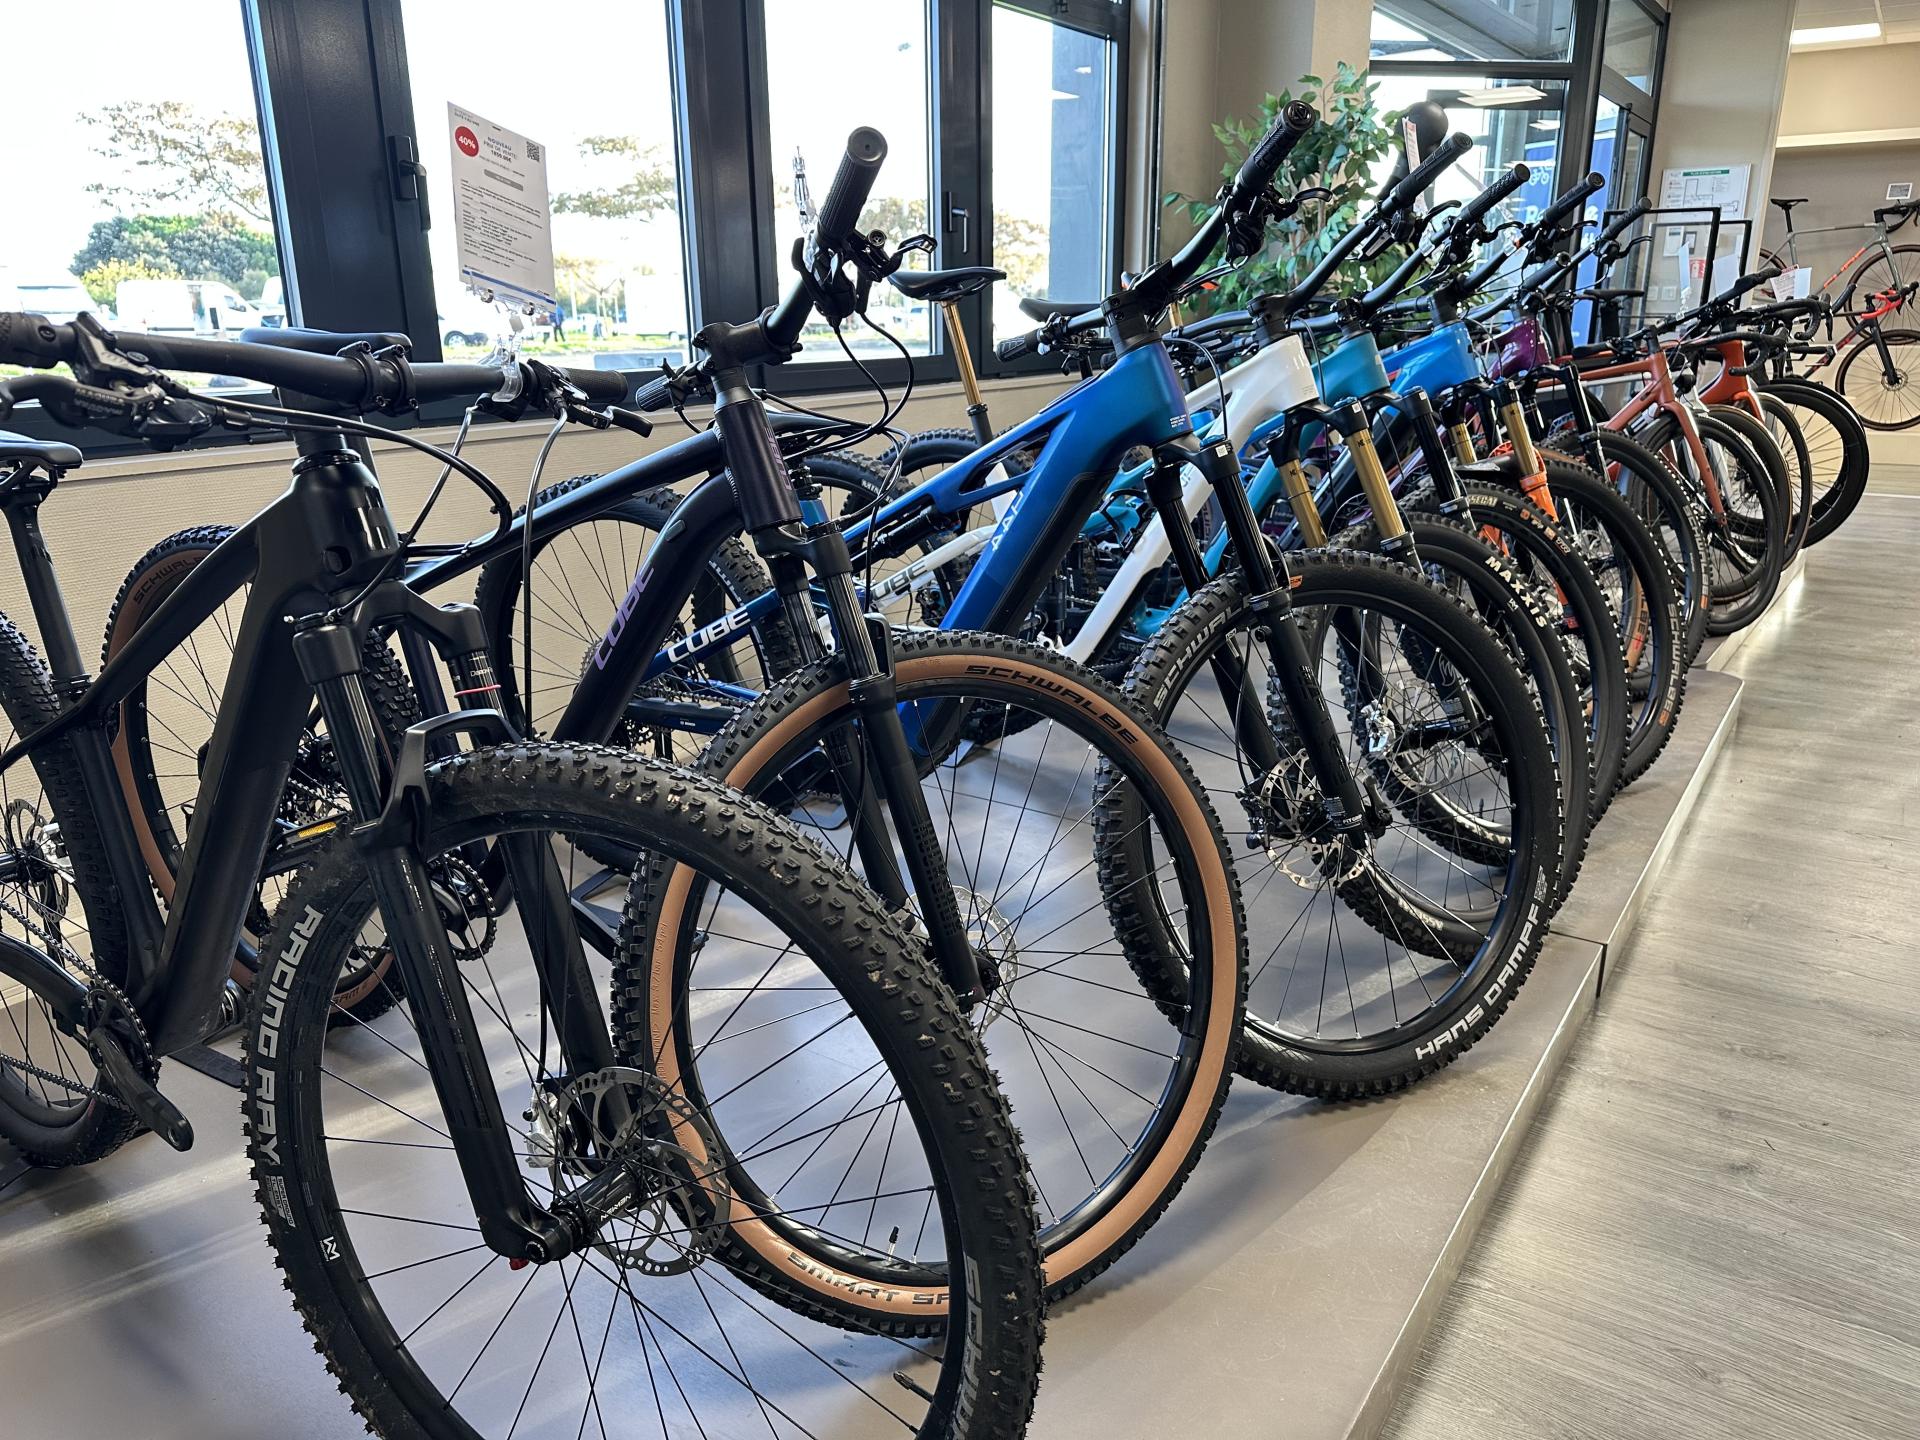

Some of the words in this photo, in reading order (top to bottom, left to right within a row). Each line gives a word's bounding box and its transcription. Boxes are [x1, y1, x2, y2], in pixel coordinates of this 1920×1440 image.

[133, 556, 204, 604] SCHWAL
[594, 567, 655, 671] CUBE
[871, 560, 927, 601] UBE
[1485, 556, 1548, 628] MAXXIS
[667, 606, 751, 664] CUBE
[1152, 593, 1253, 711] SCHWAL
[1666, 603, 1682, 712] SCHWALBE
[964, 664, 1139, 745] SCHWALBE
[257, 904, 324, 1059] RACING
[1415, 1003, 1485, 1060] HANS
[1484, 903, 1539, 1006] DAMPF
[255, 1066, 282, 1165] RAY
[787, 1251, 900, 1302] SMART
